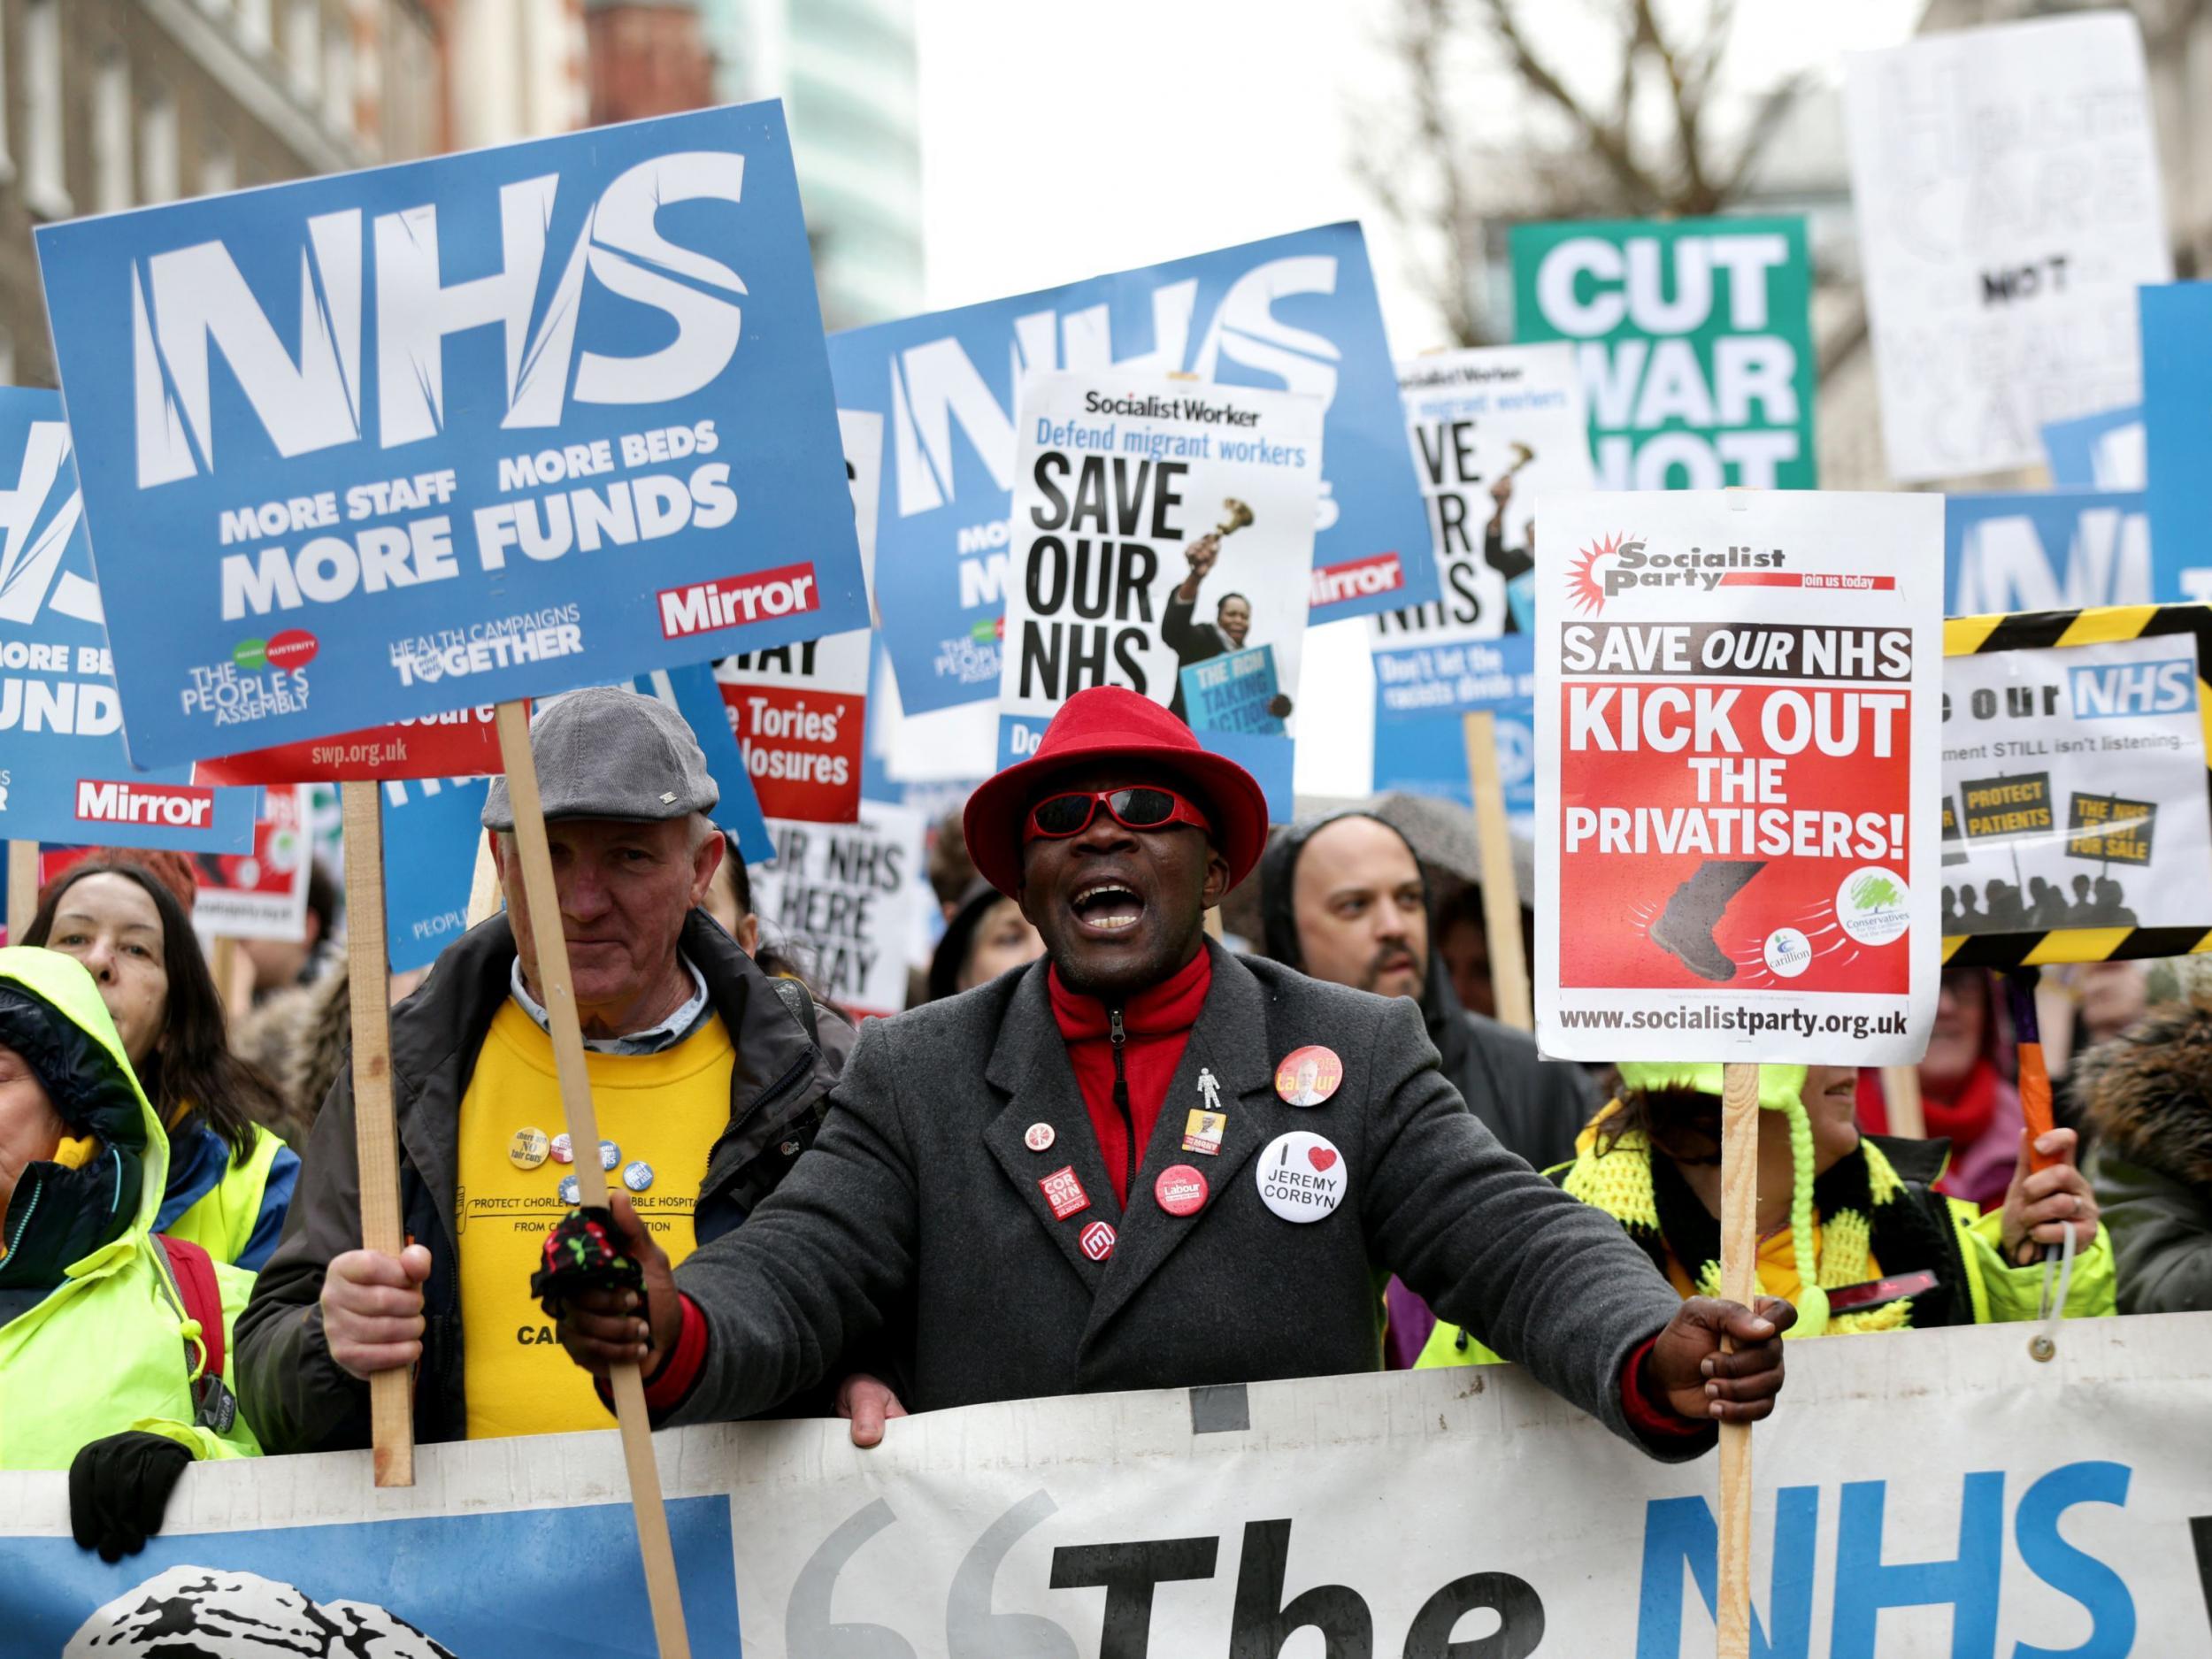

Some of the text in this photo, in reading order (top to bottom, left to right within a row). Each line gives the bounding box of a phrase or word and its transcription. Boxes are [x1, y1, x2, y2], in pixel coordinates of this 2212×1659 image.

[1538, 234, 1787, 336] CUT
[131, 150, 749, 490] NHS
[1084, 391, 1262, 428] Socialist Worker
[498, 419, 719, 493] MORE BEDS
[1036, 417, 1307, 468] Defend migrant workers
[219, 469, 457, 546] MORE STAFF
[1030, 451, 1189, 541] SAVE
[221, 515, 460, 621] MORE
[473, 463, 739, 572] FUNDS
[1617, 541, 1786, 570] Socialist
[1025, 534, 1159, 623] OUR
[1825, 576, 1839, 588] us
[1841, 575, 1874, 590] today
[662, 575, 813, 638] Mirror
[388, 603, 580, 659] HEALTH CAMPAIGNS
[0, 641, 69, 672] ORE
[268, 640, 316, 657] AUSTERITY
[1018, 620, 1150, 702] NHS
[1562, 625, 1912, 679] SAVE OUR NHS
[189, 662, 238, 688] THE
[1971, 683, 2060, 720] our
[2074, 662, 2192, 717] NHS
[215, 690, 311, 727] ASSEMBLY
[1570, 687, 1742, 753] KICK
[1760, 688, 1905, 759] OUT
[311, 738, 407, 768] swp.org.uk
[1993, 740, 2049, 757] STILL
[2055, 736, 2096, 754] isn't
[1687, 757, 1787, 804] THE
[1967, 781, 2044, 810] PROTECT
[77, 781, 212, 826] Mirror
[2076, 798, 2109, 819] THE
[1564, 806, 1904, 861] PRIVATISERS!
[1969, 807, 2052, 837] PATIENTS
[2070, 838, 2147, 861] FOR SALE
[1846, 912, 1910, 929] Conservatives
[1770, 949, 1811, 970] carillion
[1560, 1005, 1908, 1039] www.socialistparty.org.uk
[1276, 1072, 1336, 1092] Laur
[1280, 1142, 1288, 1166] I
[1044, 1173, 1076, 1194] COR
[1049, 1183, 1081, 1207] BYN
[1164, 1183, 1200, 1196] Labour
[1268, 1169, 1337, 1192] JEREMY
[474, 1198, 520, 1210] PROTECT
[1264, 1185, 1335, 1210] CORBYN
[514, 1222, 546, 1233] FROM
[1636, 1460, 2137, 1659] NHS
